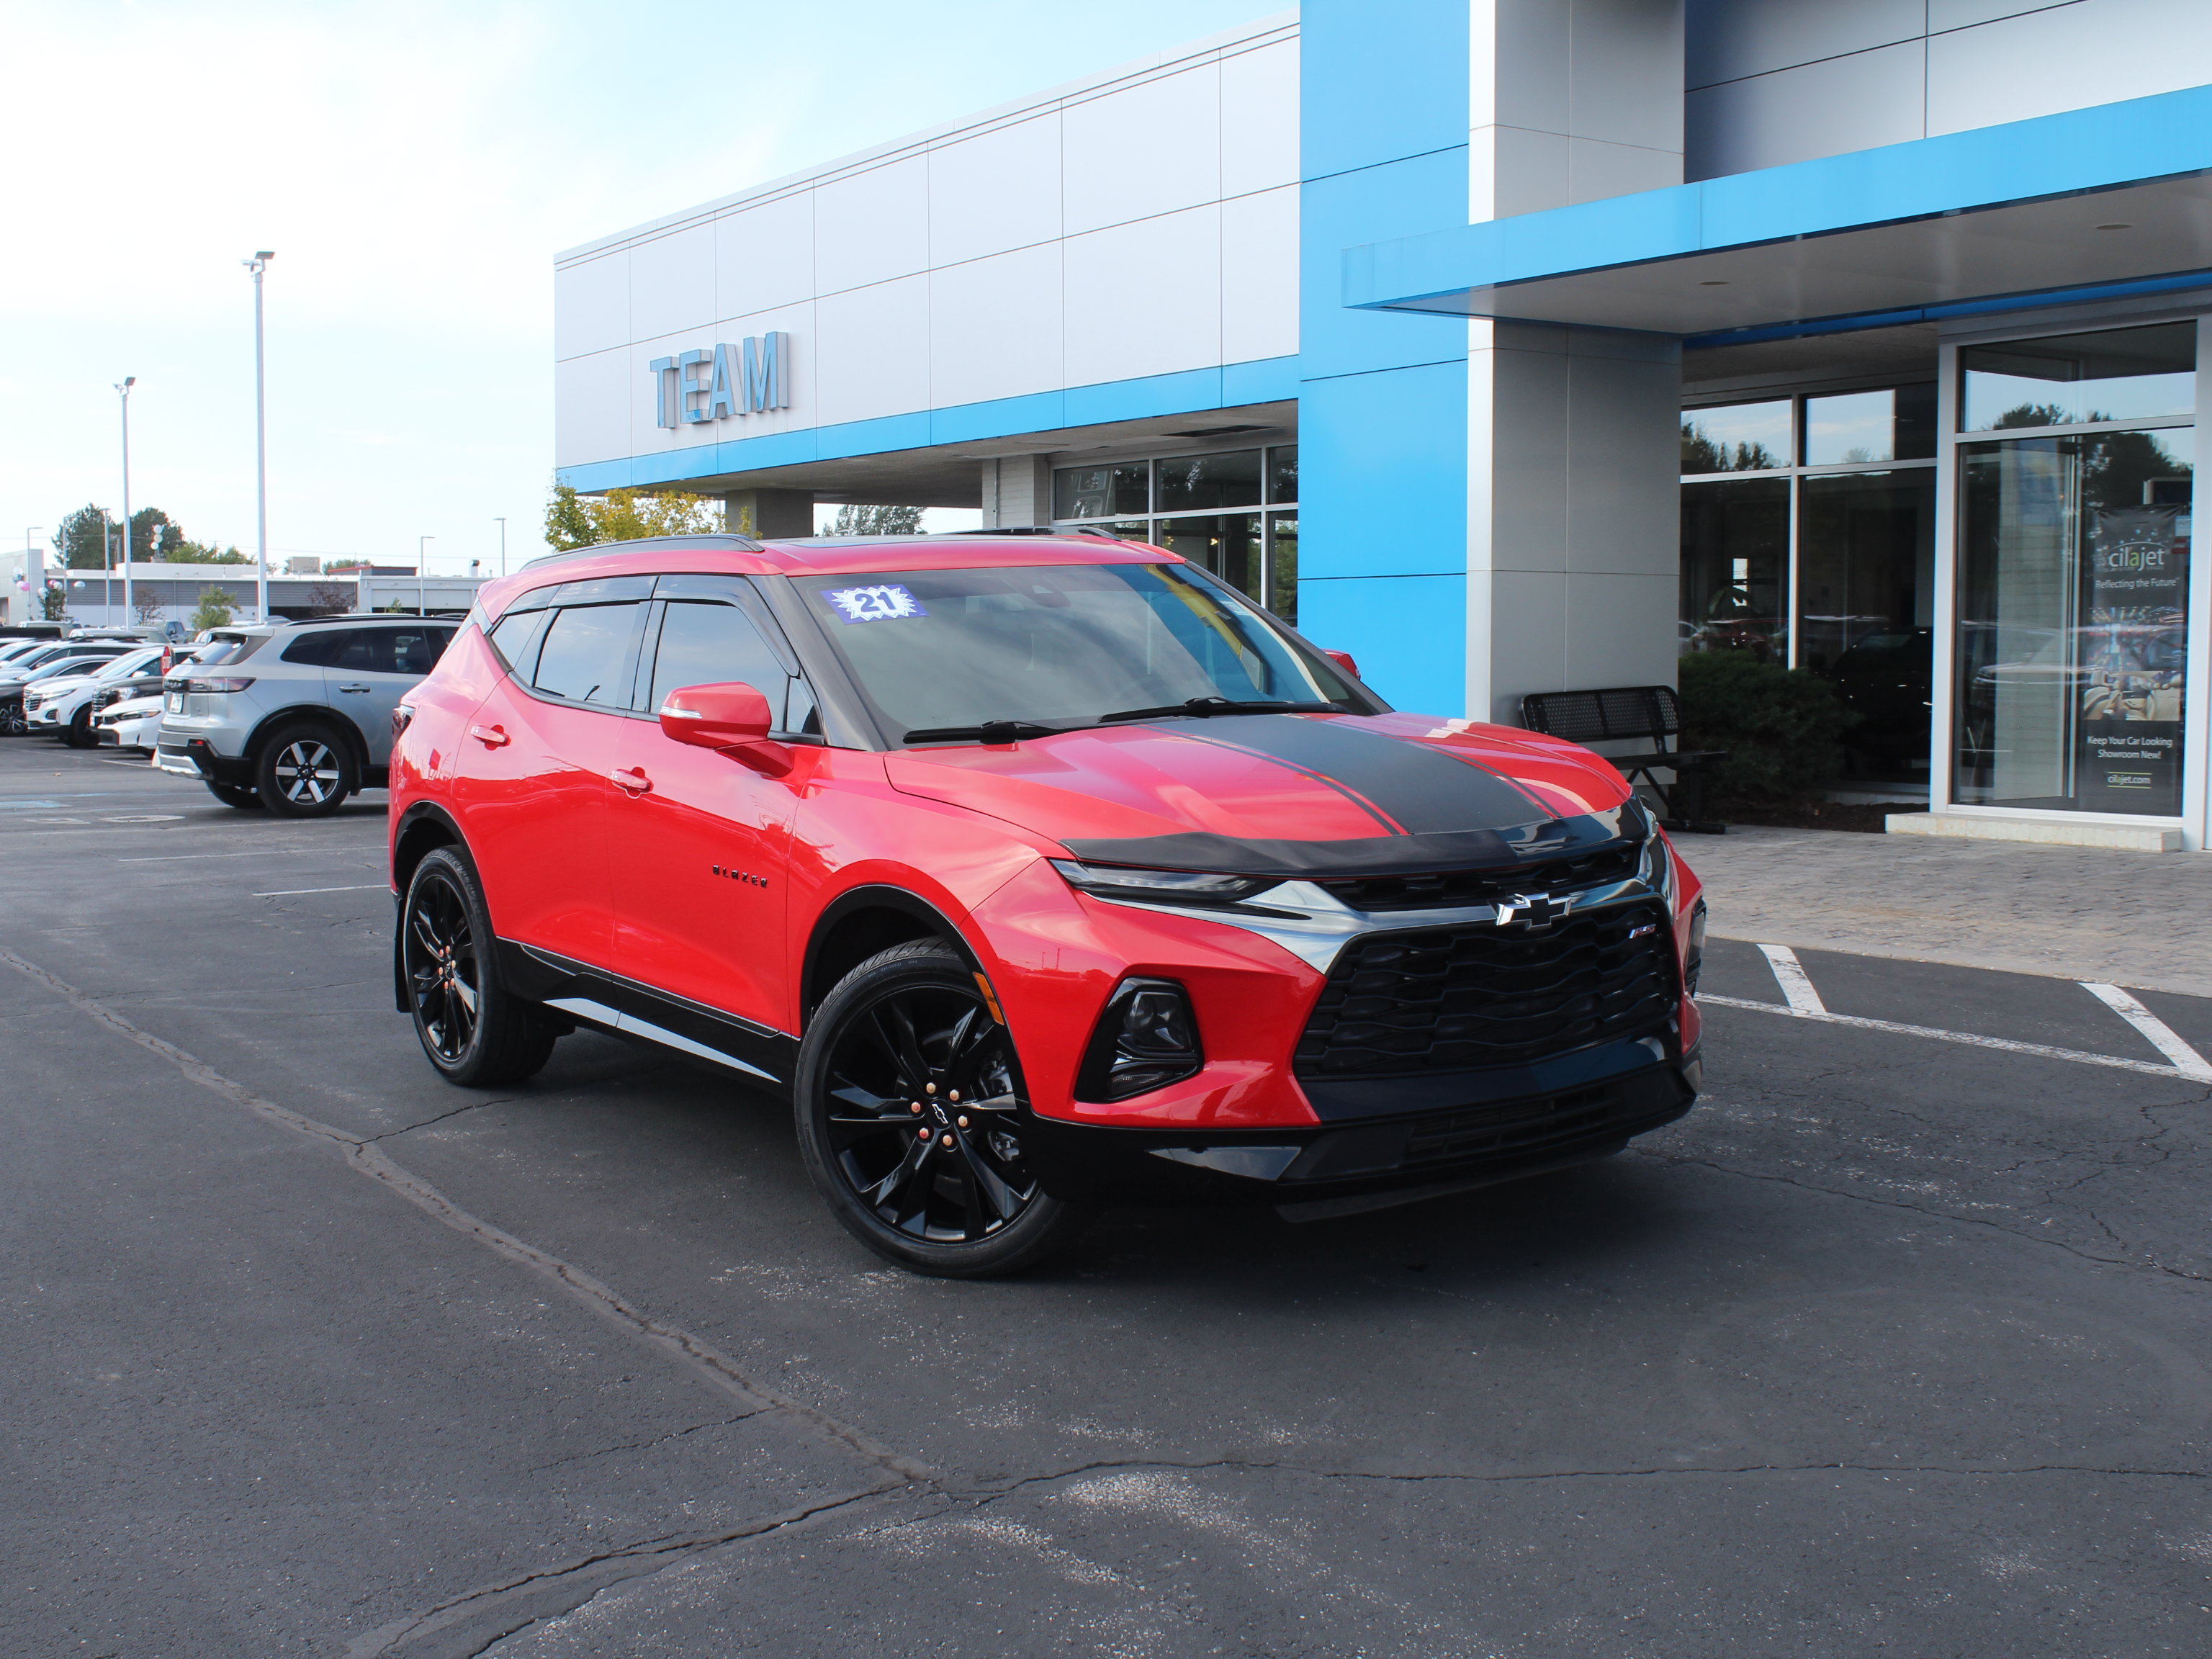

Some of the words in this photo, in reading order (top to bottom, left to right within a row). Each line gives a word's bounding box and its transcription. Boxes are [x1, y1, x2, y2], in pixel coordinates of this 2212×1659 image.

[650, 331, 788, 428] TEAM
[2108, 547, 2164, 571] cilajet
[2095, 579, 2134, 590] Reflecting
[2136, 578, 2149, 588] the
[854, 591, 896, 612] 21
[163, 656, 171, 669] STOP
[2087, 736, 2108, 746] Keep
[2126, 737, 2140, 745] Car
[2141, 737, 2173, 748] Looking
[2098, 749, 2139, 758] Showroom
[2108, 775, 2151, 785] cilajet.com
[713, 865, 768, 889] BLAZER
